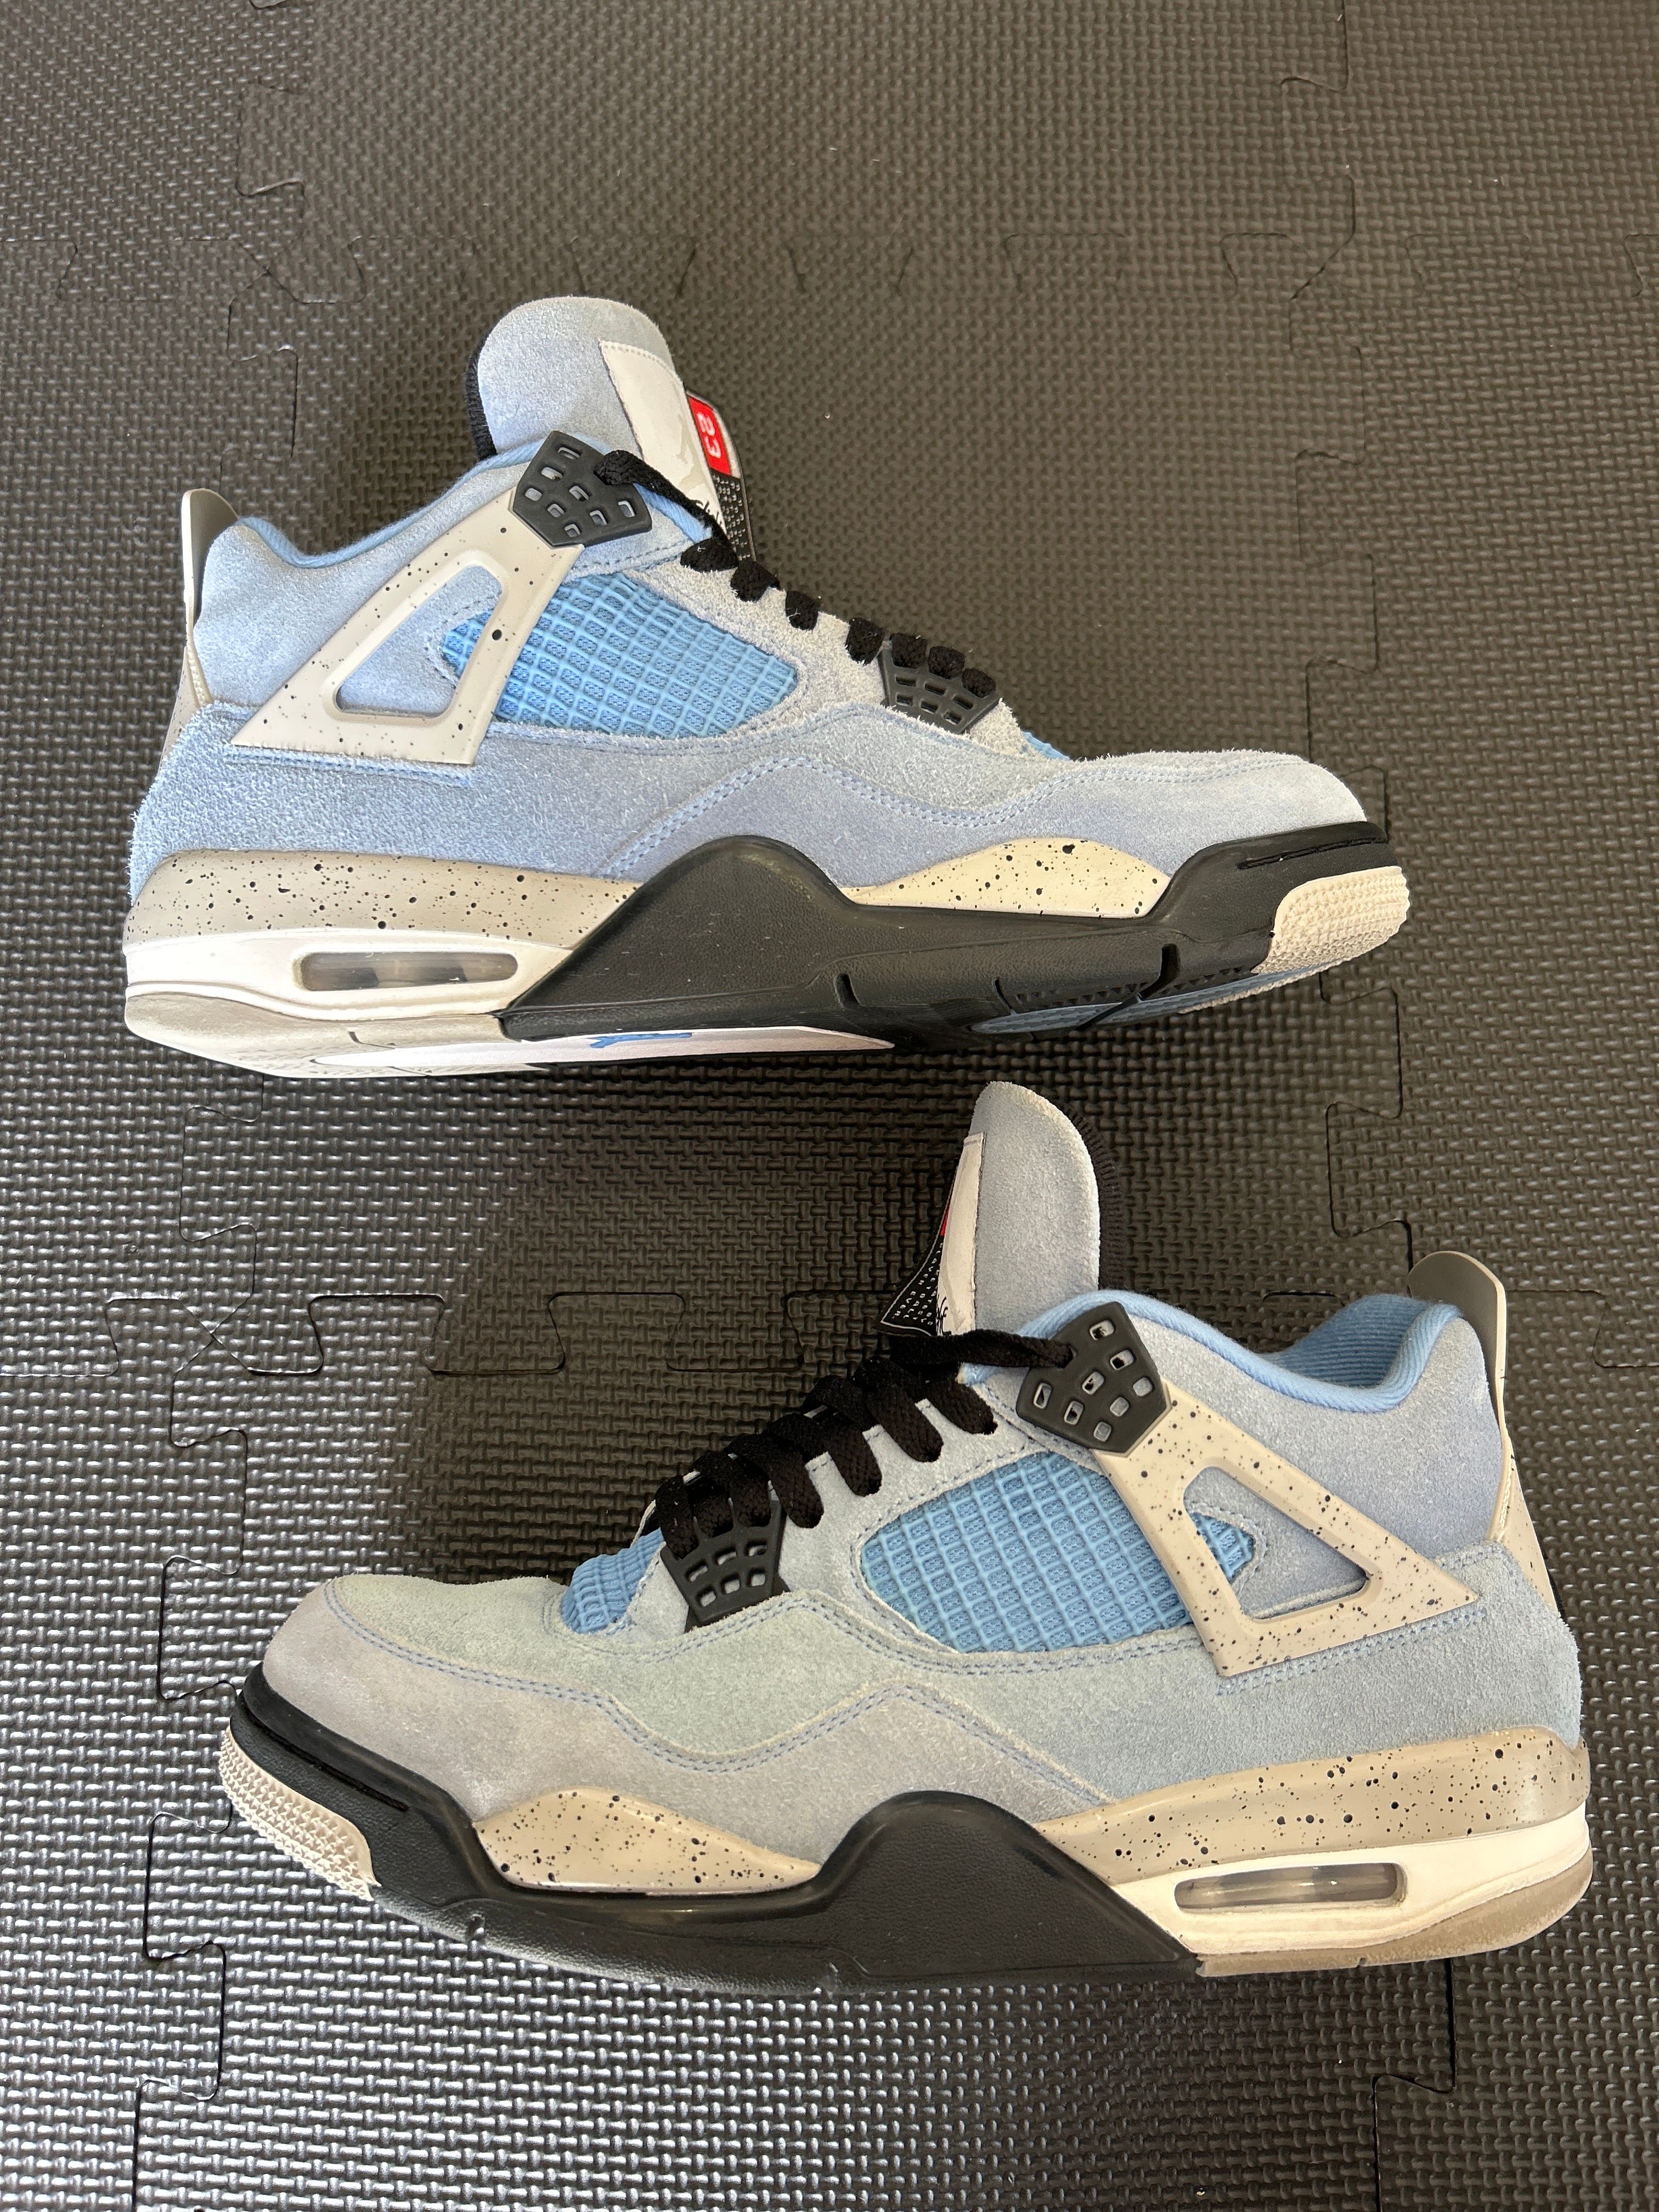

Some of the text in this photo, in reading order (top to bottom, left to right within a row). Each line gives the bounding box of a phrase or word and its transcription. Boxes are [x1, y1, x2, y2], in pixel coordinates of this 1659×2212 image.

[697, 413, 721, 459] 23
[903, 1269, 940, 1318] KETBALL
[913, 1285, 938, 1320] ATEST
